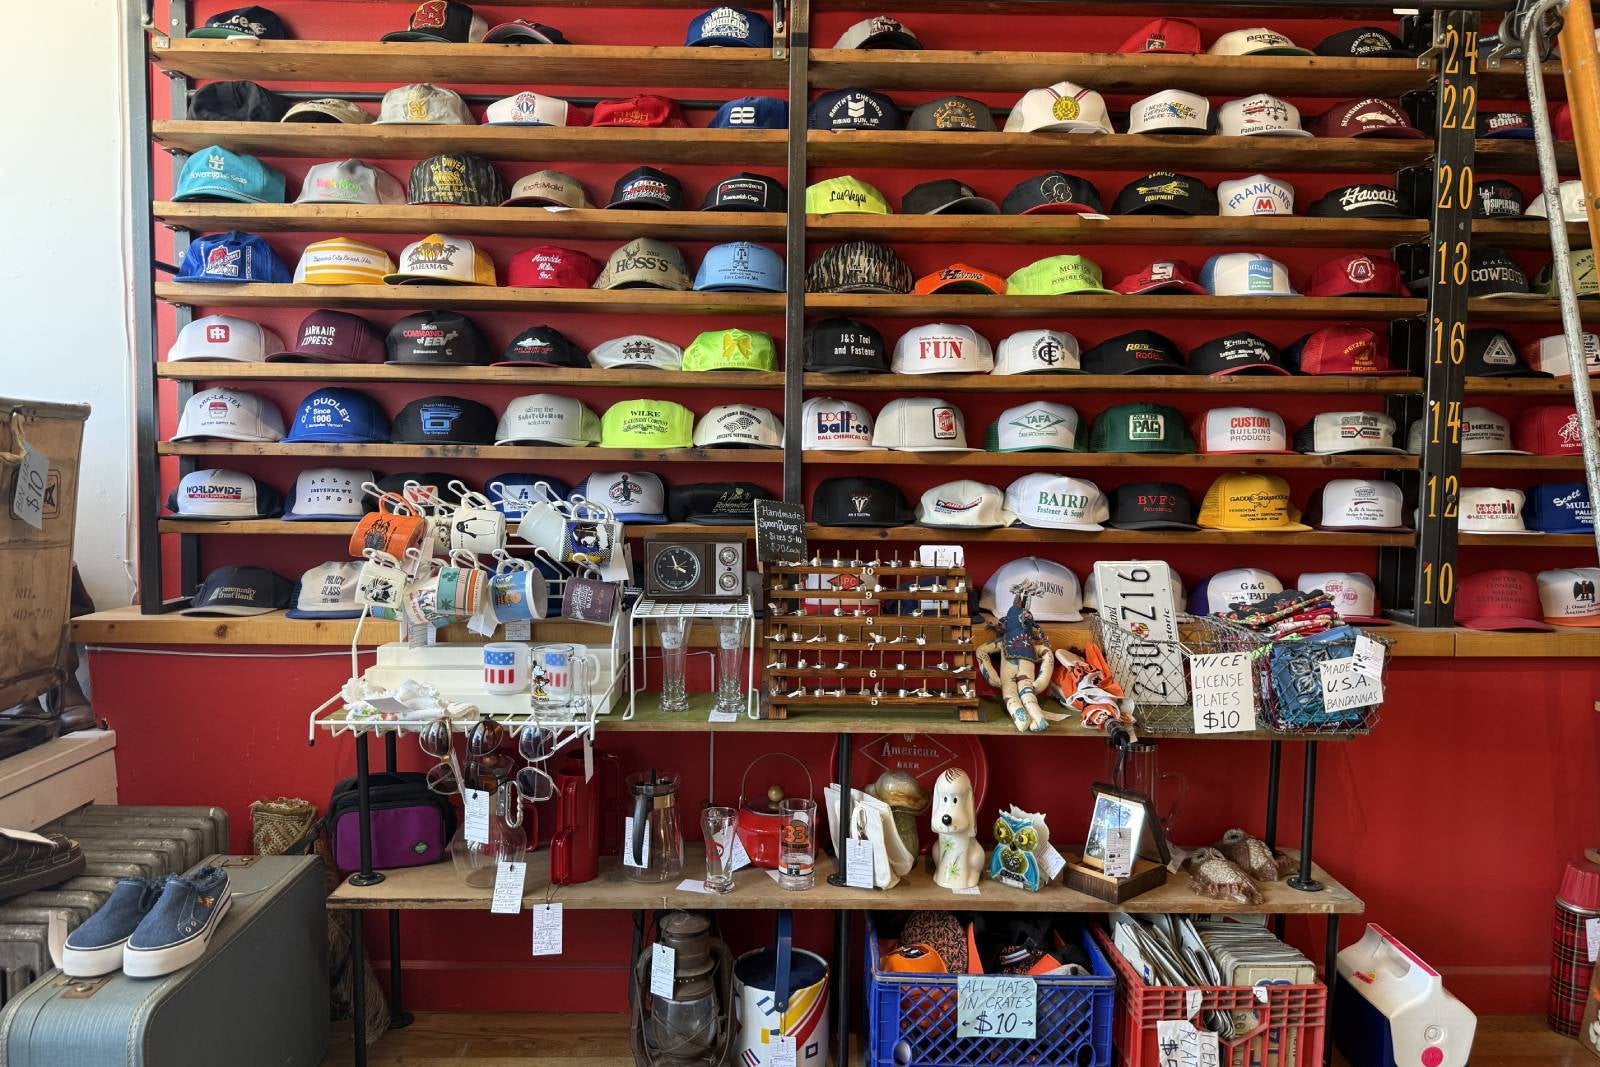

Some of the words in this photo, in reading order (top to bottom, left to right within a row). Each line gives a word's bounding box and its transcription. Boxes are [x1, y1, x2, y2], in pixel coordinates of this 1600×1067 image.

[1445, 28, 1478, 75] 24
[829, 95, 852, 117] SMITH'S
[856, 93, 883, 117] CHEVRON
[1341, 98, 1373, 127] SUNSHINE
[1443, 84, 1475, 130] 22
[1241, 126, 1264, 134] Panama
[1437, 164, 1473, 210] 20
[830, 190, 846, 202] Las
[846, 191, 867, 207] Vegas
[1144, 194, 1175, 202] EQUIPMENT
[1339, 187, 1399, 206] Hawaii
[616, 257, 672, 275] HOSS'S
[1438, 241, 1468, 286] 18
[1471, 267, 1524, 285] COWBOYS
[840, 334, 855, 343] J&S
[859, 335, 870, 344] Tool
[1434, 321, 1465, 365] 16
[834, 346, 849, 355] and
[851, 346, 876, 356] Fastener
[919, 341, 964, 360] FUN
[312, 415, 332, 423] 1906
[313, 397, 352, 424] DUDLEY
[1026, 415, 1052, 424] TAFA
[817, 411, 869, 434] ball-co
[1231, 417, 1271, 427] CUSTOM
[1432, 402, 1460, 443] 14
[26, 470, 44, 513] $10
[187, 486, 242, 494] WORLDWIDE
[1428, 475, 1458, 518] 12
[1553, 489, 1581, 507] Scott
[1039, 491, 1089, 510] BAIRD
[1477, 504, 1501, 514] case
[761, 506, 801, 521] Handmade
[1037, 505, 1060, 515] Fastener
[1063, 507, 1069, 515] &
[861, 568, 876, 579] 10
[220, 586, 256, 594] Community
[1424, 563, 1453, 605] 10
[235, 592, 253, 600] Bank
[864, 591, 875, 600] 9
[1116, 569, 1157, 621] Z16
[865, 616, 875, 625] 8
[867, 642, 876, 651] 7
[1194, 655, 1241, 668] NICE
[1325, 662, 1351, 674] MADE
[869, 669, 877, 678] 6
[1194, 672, 1243, 690] LICENSE
[1327, 674, 1370, 693] U.S.A.
[871, 696, 879, 705] 5
[1195, 692, 1240, 708] PLATES
[1327, 691, 1378, 709] BANDANNAS
[1202, 709, 1240, 729] $10
[881, 742, 939, 758] American
[961, 980, 987, 996] ALL
[996, 979, 1031, 998] HATS
[963, 998, 977, 1010] IN
[984, 996, 1032, 1009] CRATES
[974, 1011, 1018, 1035] $10
